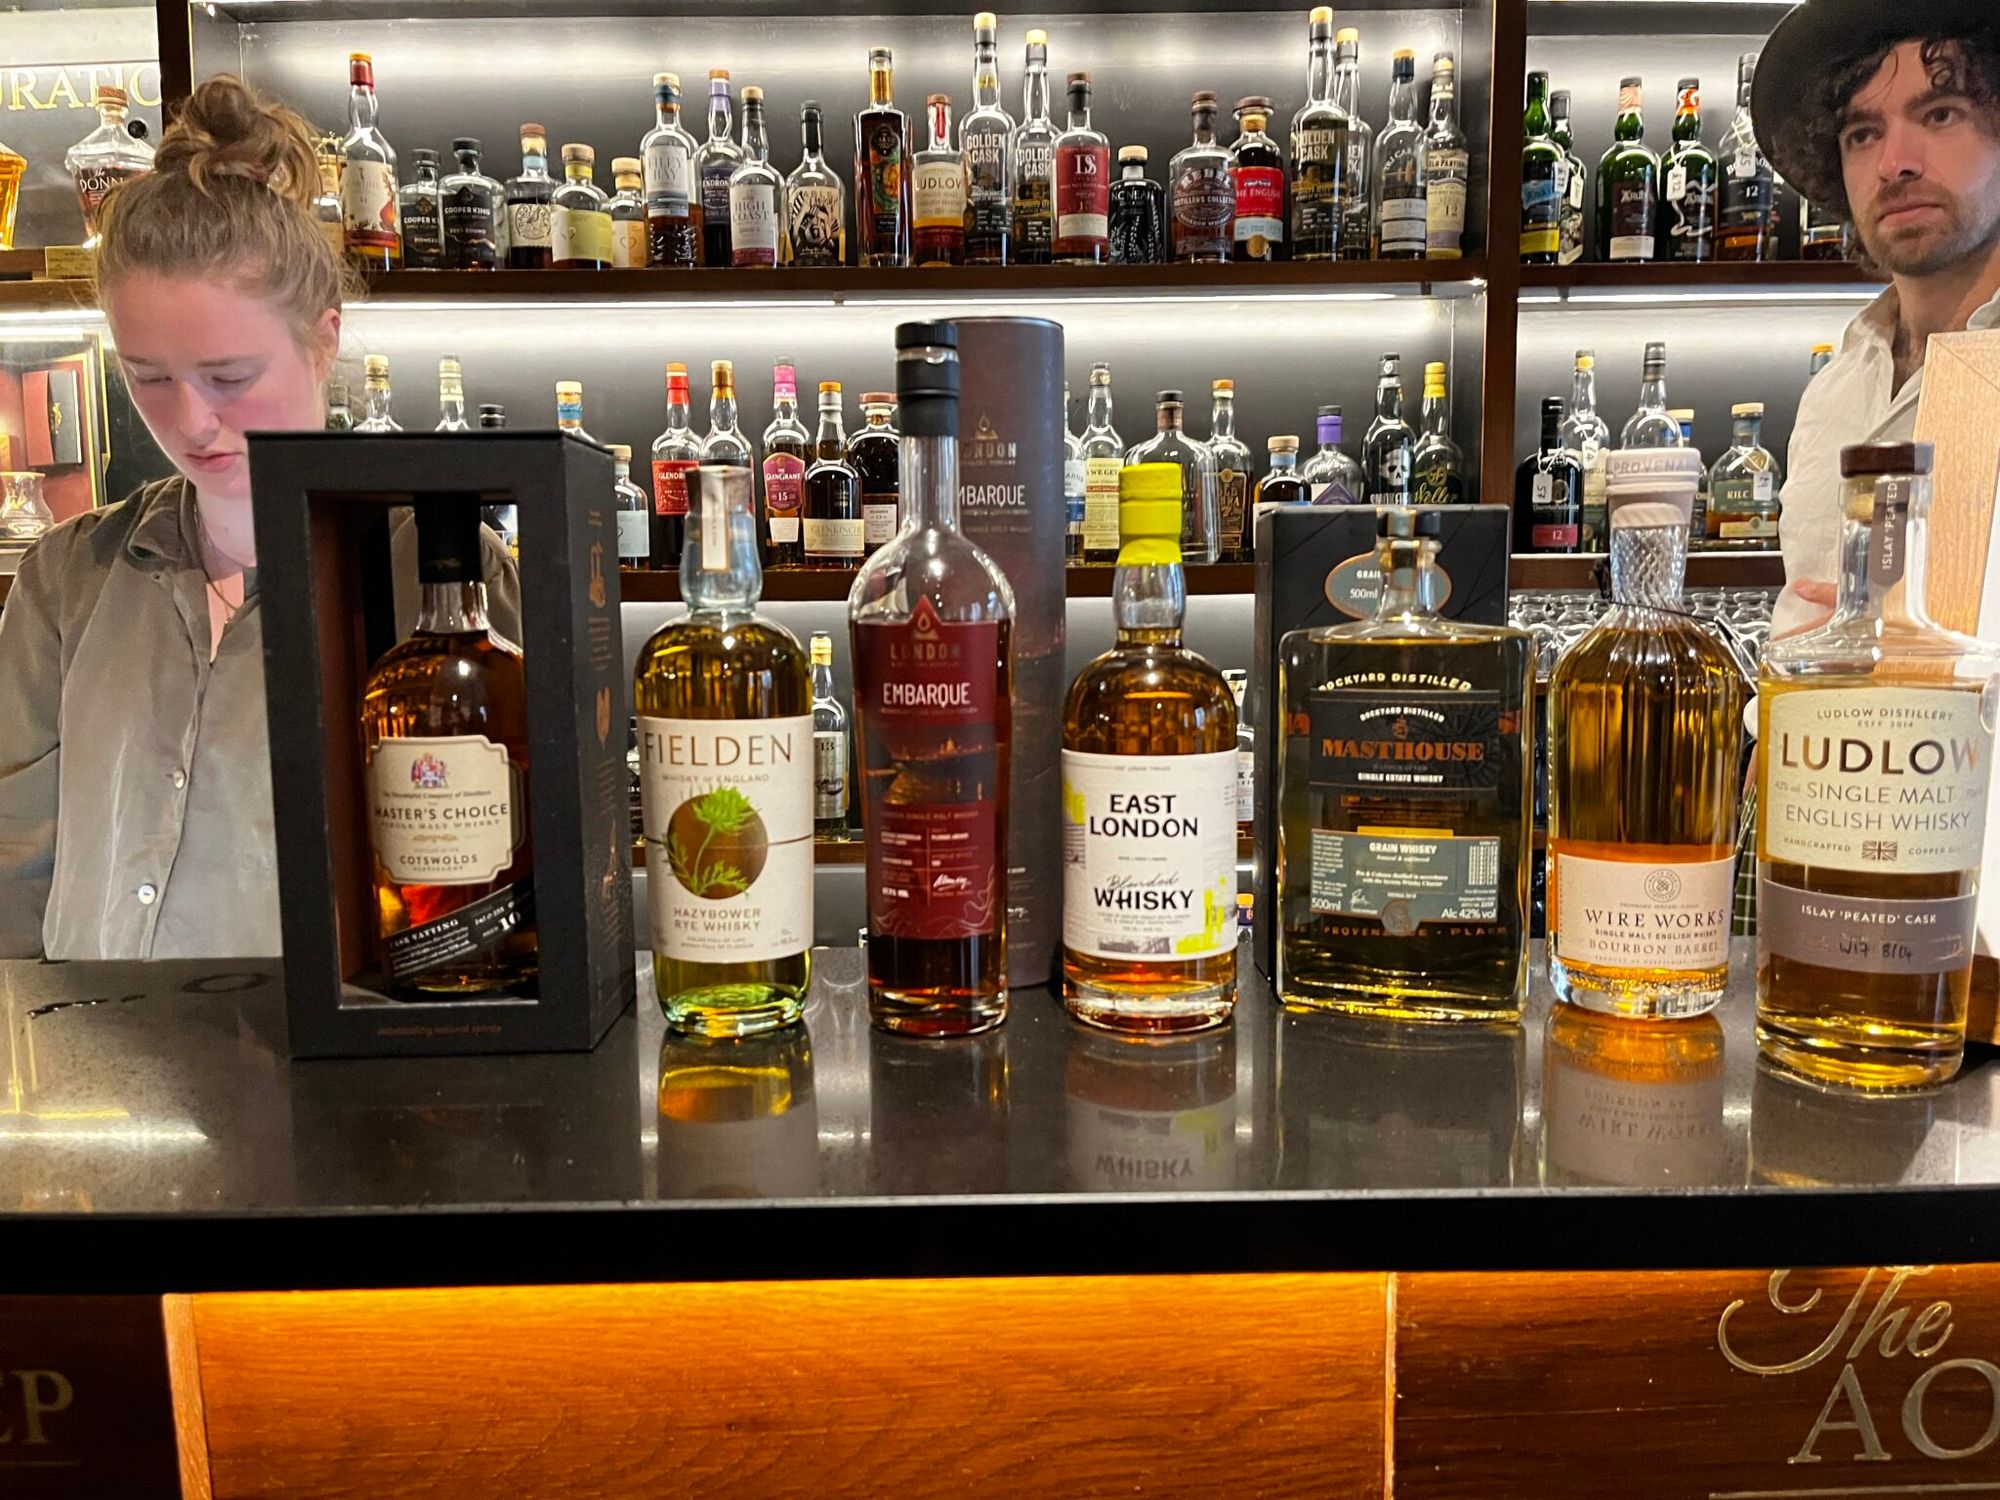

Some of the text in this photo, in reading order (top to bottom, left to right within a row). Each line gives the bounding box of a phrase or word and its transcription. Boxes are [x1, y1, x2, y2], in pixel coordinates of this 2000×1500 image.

[0, 64, 162, 110] RATIO
[966, 134, 1005, 149] GOLDEN
[1300, 130, 1335, 145] OLDEN
[972, 148, 1000, 164] CASK
[1302, 146, 1328, 161] CASK
[1745, 186, 1759, 198] 12
[472, 207, 490, 216] KING
[735, 202, 765, 211] HIGH
[732, 211, 769, 222] COAST
[778, 492, 788, 502] 15
[1552, 530, 1564, 540] 12
[1881, 536, 1894, 571] ISLAY
[1350, 588, 1378, 600] 500ml
[1391, 672, 1473, 692] DISTILLED
[883, 682, 971, 709] EMBARQUE
[1360, 706, 1446, 723] DOCKYARD DISTILLED
[1816, 708, 1954, 721] LUDLOW DISTILLERY
[644, 732, 792, 767] FIELDEN
[1322, 738, 1484, 762] MASTHOUSE
[1781, 732, 1980, 776] LUDLOW
[662, 774, 699, 784] WHISKY
[716, 774, 770, 784] ENGLAND
[1358, 772, 1384, 782] SINGLE
[1413, 774, 1444, 784] WHISKY
[1806, 782, 1892, 804] SINGLE
[1899, 786, 1956, 805] MALT
[443, 802, 509, 820] CHOICE
[1110, 794, 1177, 814] EAST
[1785, 804, 1972, 832] ENGLISH WHISKY
[1090, 816, 1198, 838] LONDON
[1368, 842, 1438, 854] GRAIN WHISKY
[1783, 836, 1946, 856] HANDCRAFTED COPPER
[400, 854, 479, 866] COTSWOLDS
[1106, 870, 1180, 890] Blended
[1094, 887, 1194, 911] WHISKY
[1312, 897, 1342, 912] 500ml
[674, 907, 762, 920] HAZYBOWER
[1440, 907, 1497, 920] Alc 42% vol
[1585, 908, 1725, 930] WIRE WORKS
[1800, 904, 1938, 924] ISLAY 'PEATED' CASK
[674, 919, 762, 932] RYE WHISKY
[1595, 928, 1718, 940] SINGLE MALT ENGLISH WHISKY
[1588, 938, 1720, 956] BOURBON BARREL
[1718, 1266, 1955, 1375] The
[0, 1370, 75, 1444] P
